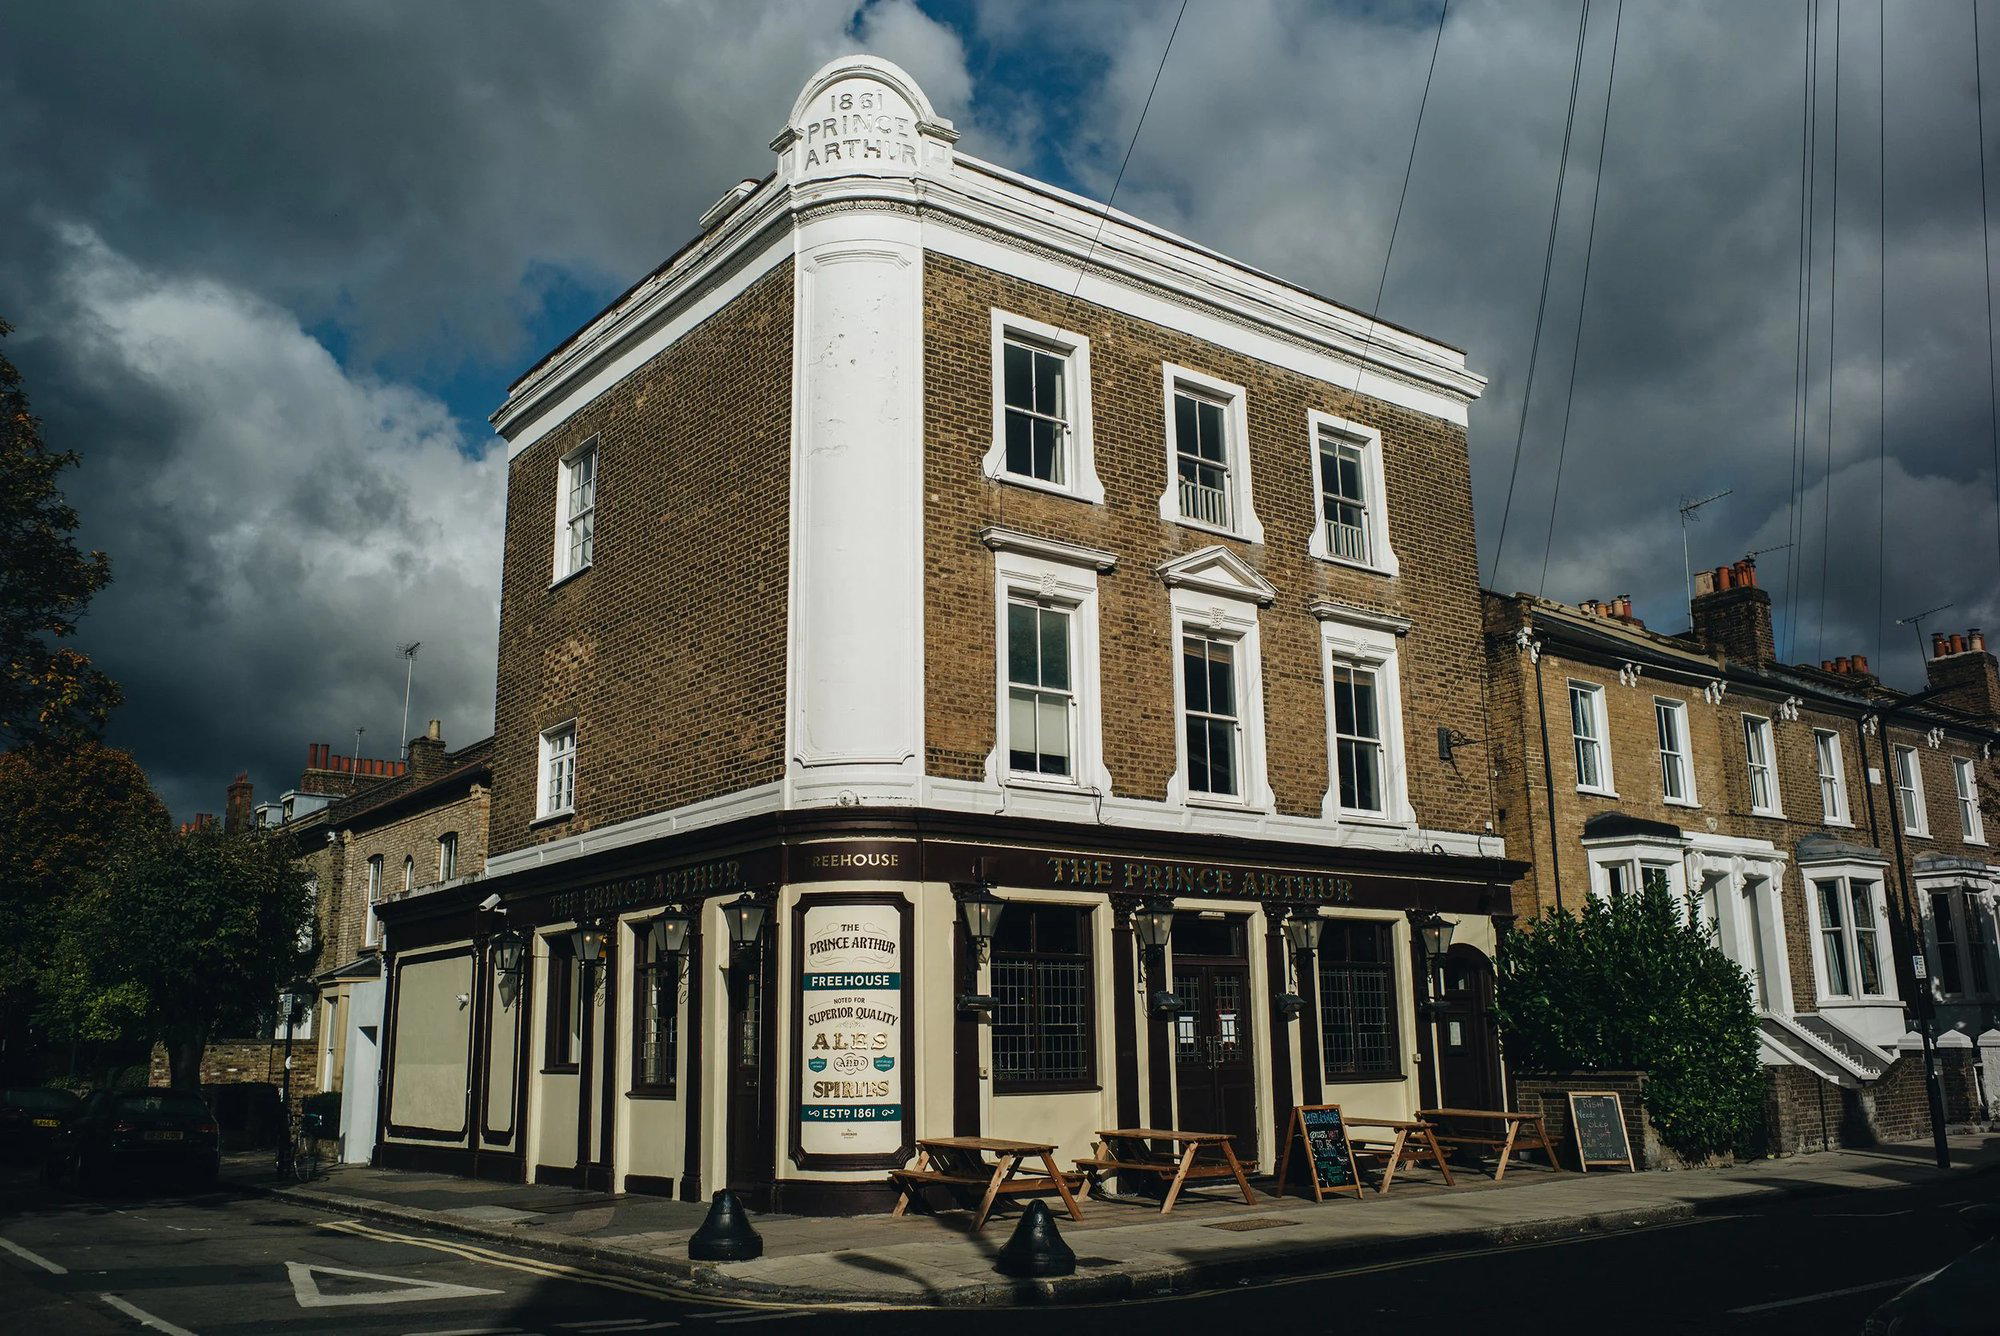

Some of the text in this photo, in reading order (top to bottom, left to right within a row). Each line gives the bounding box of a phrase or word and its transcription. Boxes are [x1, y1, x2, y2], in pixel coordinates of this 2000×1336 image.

[830, 91, 883, 112] 1861
[808, 114, 909, 144] PRINCE
[805, 139, 918, 171] ARTHUR
[584, 877, 648, 913] PRINCE
[651, 859, 741, 899] ARTHUR
[1047, 857, 1354, 901] THE PRINCE ARTHUR
[841, 924, 860, 932] THE
[809, 936, 896, 956] PRINCE ARTHUR
[811, 975, 890, 987] FREEHOUSE
[808, 1006, 899, 1027] SUPERIOR QUALITY
[811, 1032, 889, 1051] ALES
[812, 1080, 890, 1099] SPIRITS
[853, 1108, 876, 1118] 1861
